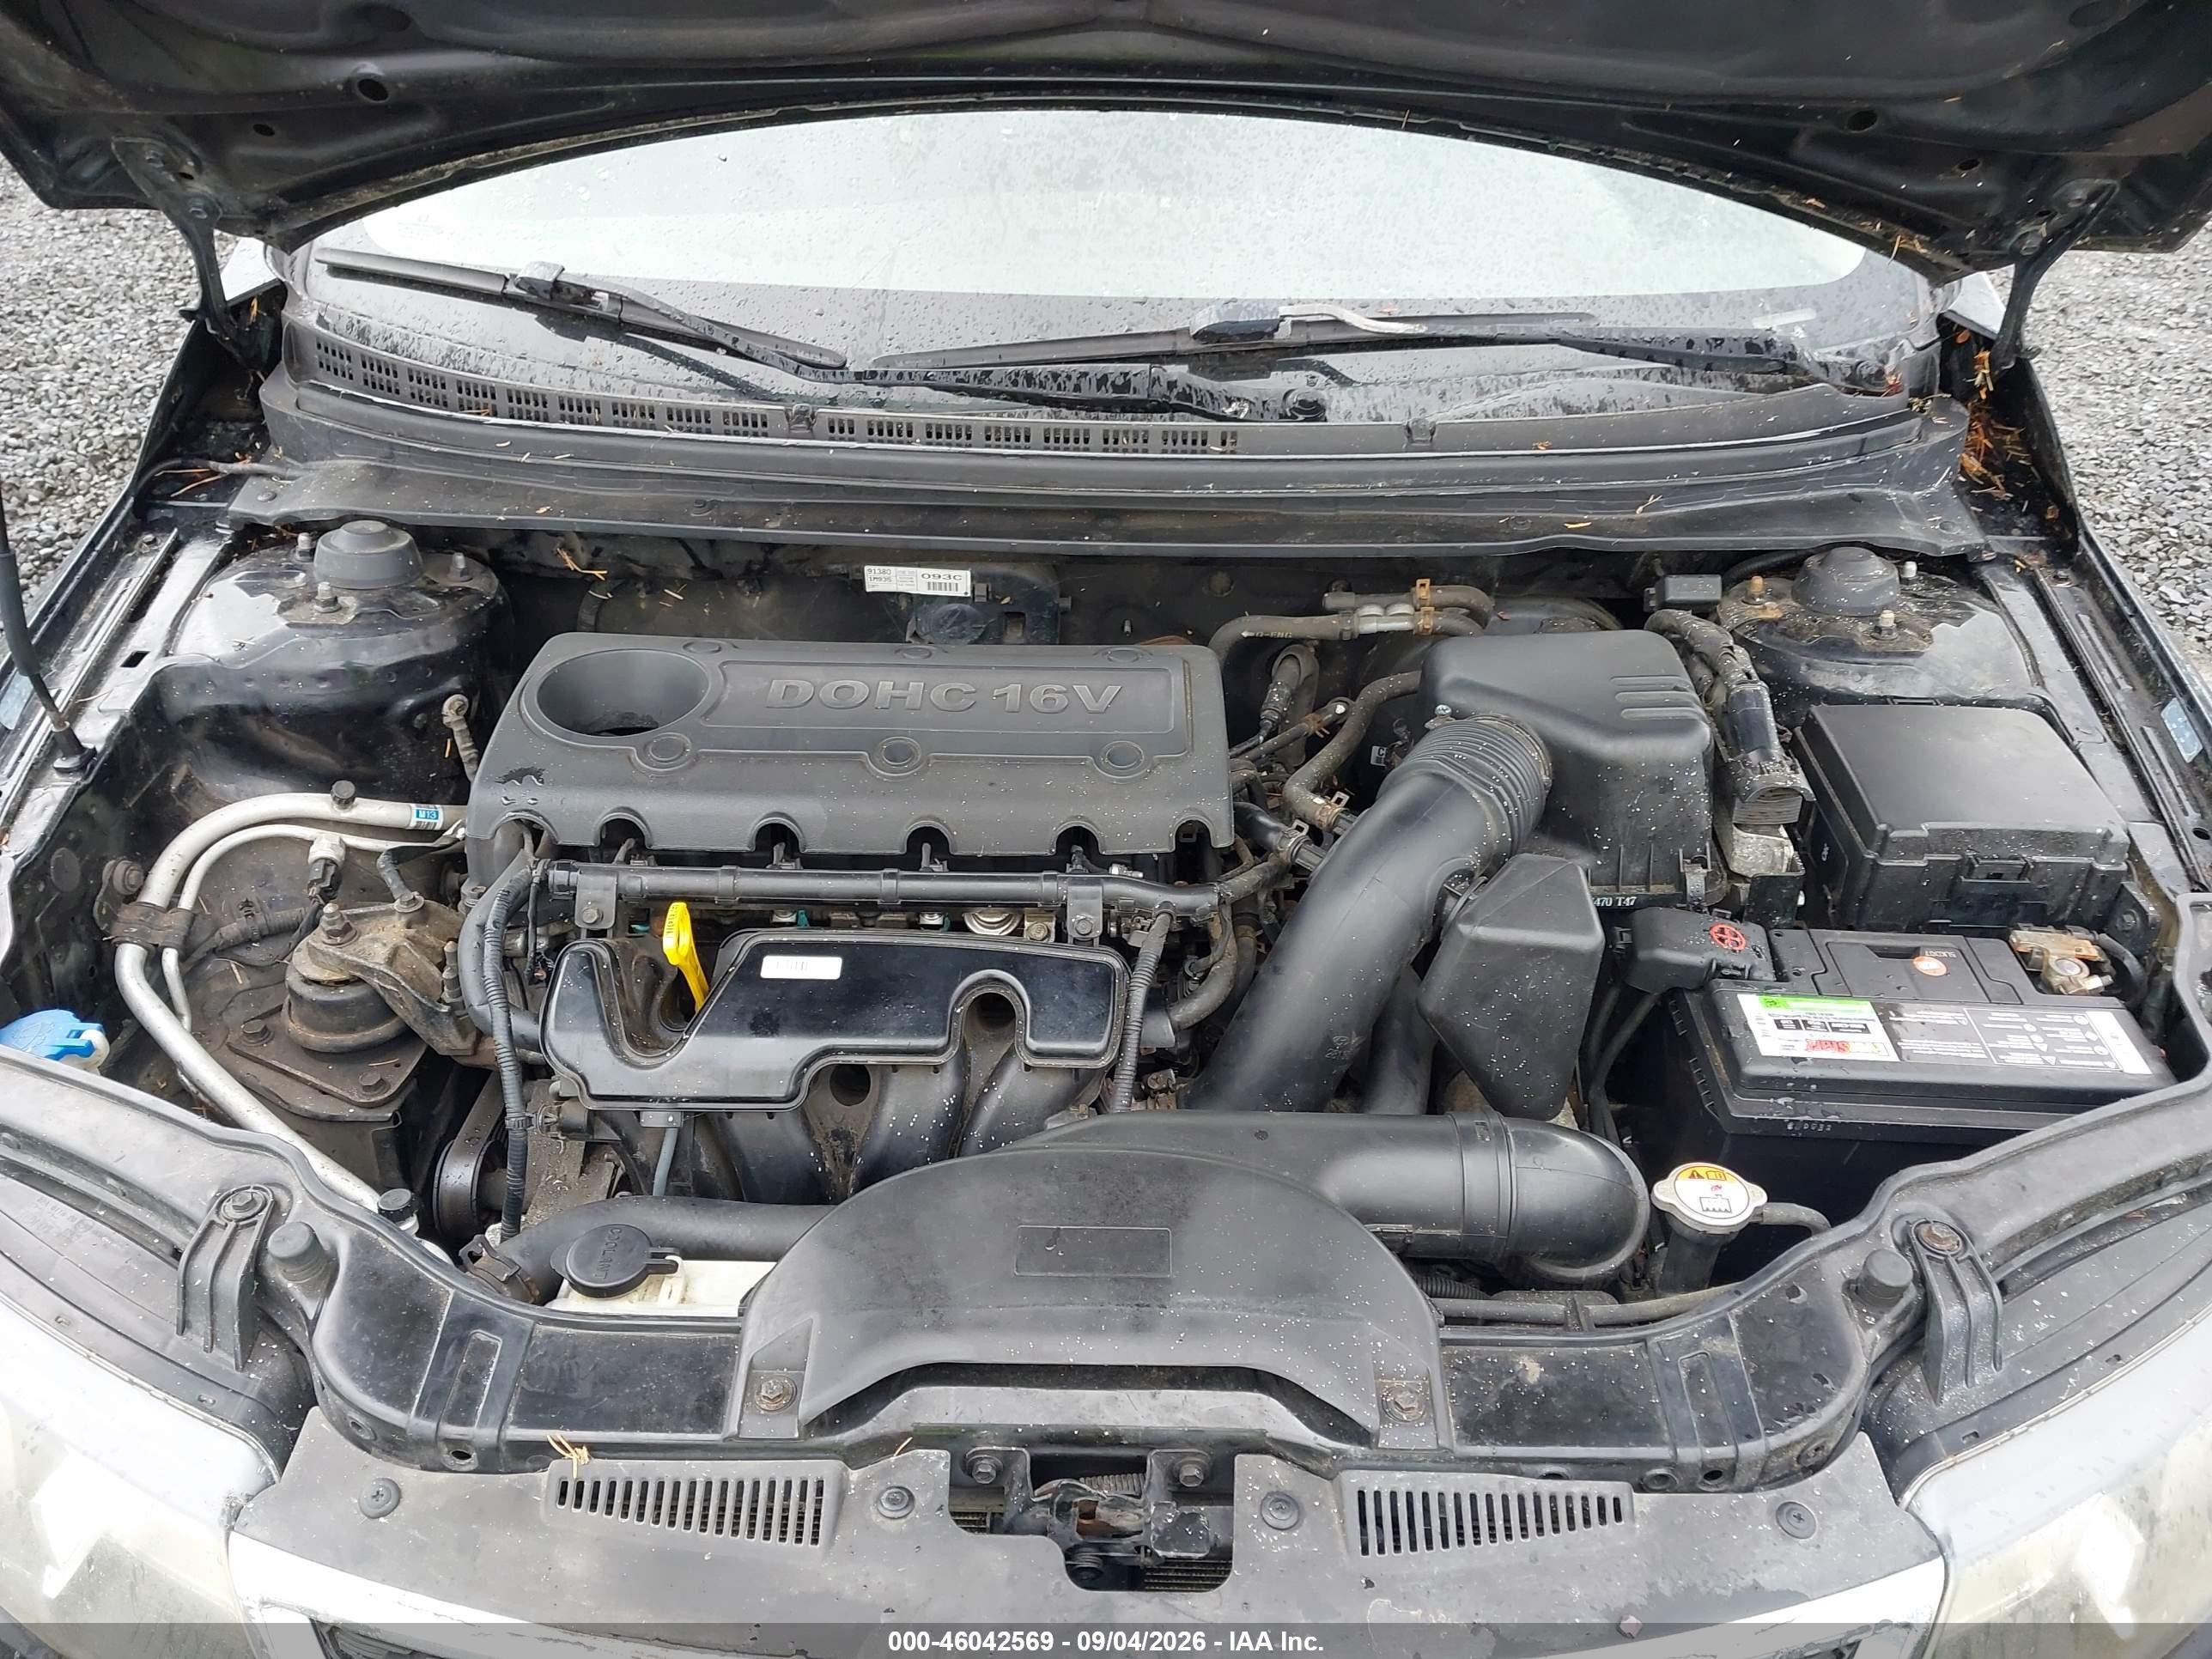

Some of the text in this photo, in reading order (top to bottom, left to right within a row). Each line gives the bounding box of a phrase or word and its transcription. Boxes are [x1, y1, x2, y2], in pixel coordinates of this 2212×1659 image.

[921, 573, 963, 581] 093C
[766, 679, 1122, 714] DOHC 16V
[418, 810, 437, 819] M13
[1592, 896, 1638, 907] 470 T47
[592, 1226, 623, 1280] COOLANT
